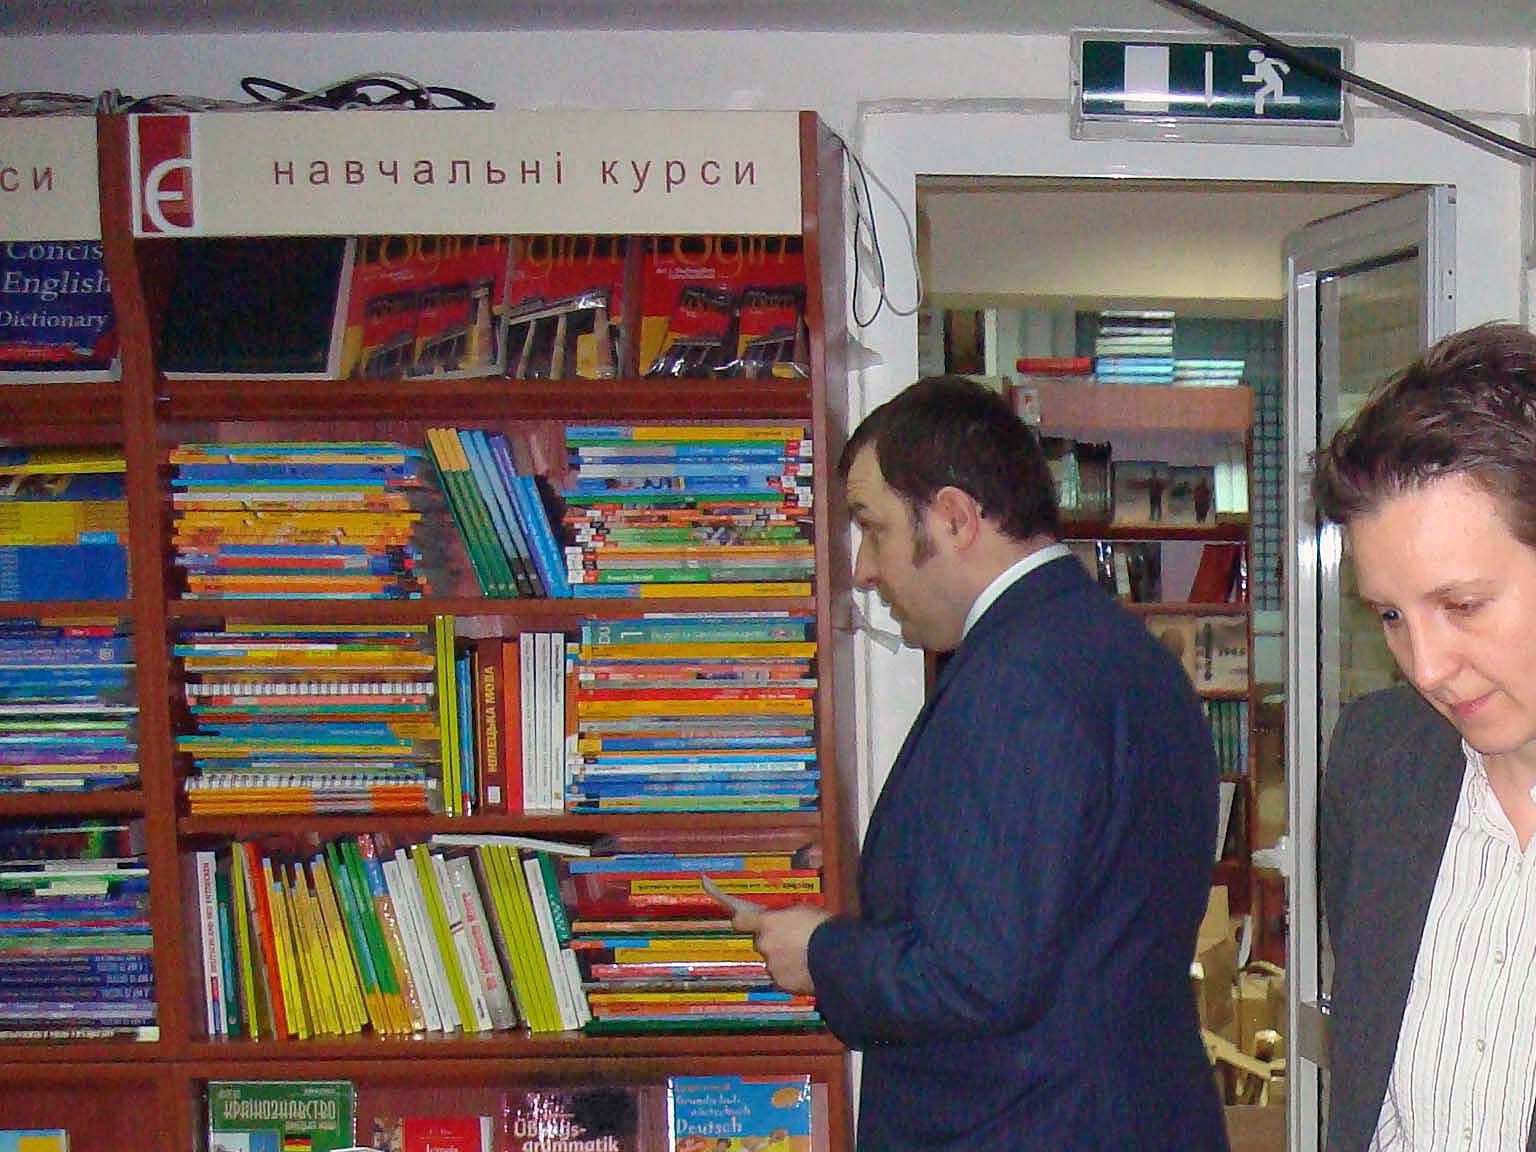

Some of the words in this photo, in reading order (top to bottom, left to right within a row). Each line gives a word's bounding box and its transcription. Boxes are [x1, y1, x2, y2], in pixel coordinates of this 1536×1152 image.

[274, 152, 562, 186] навчальні
[600, 158, 757, 193] курси
[7, 242, 104, 261] Concis
[4, 269, 112, 301] English
[0, 311, 109, 332] Dictionary
[676, 1116, 743, 1135] Deutsch
